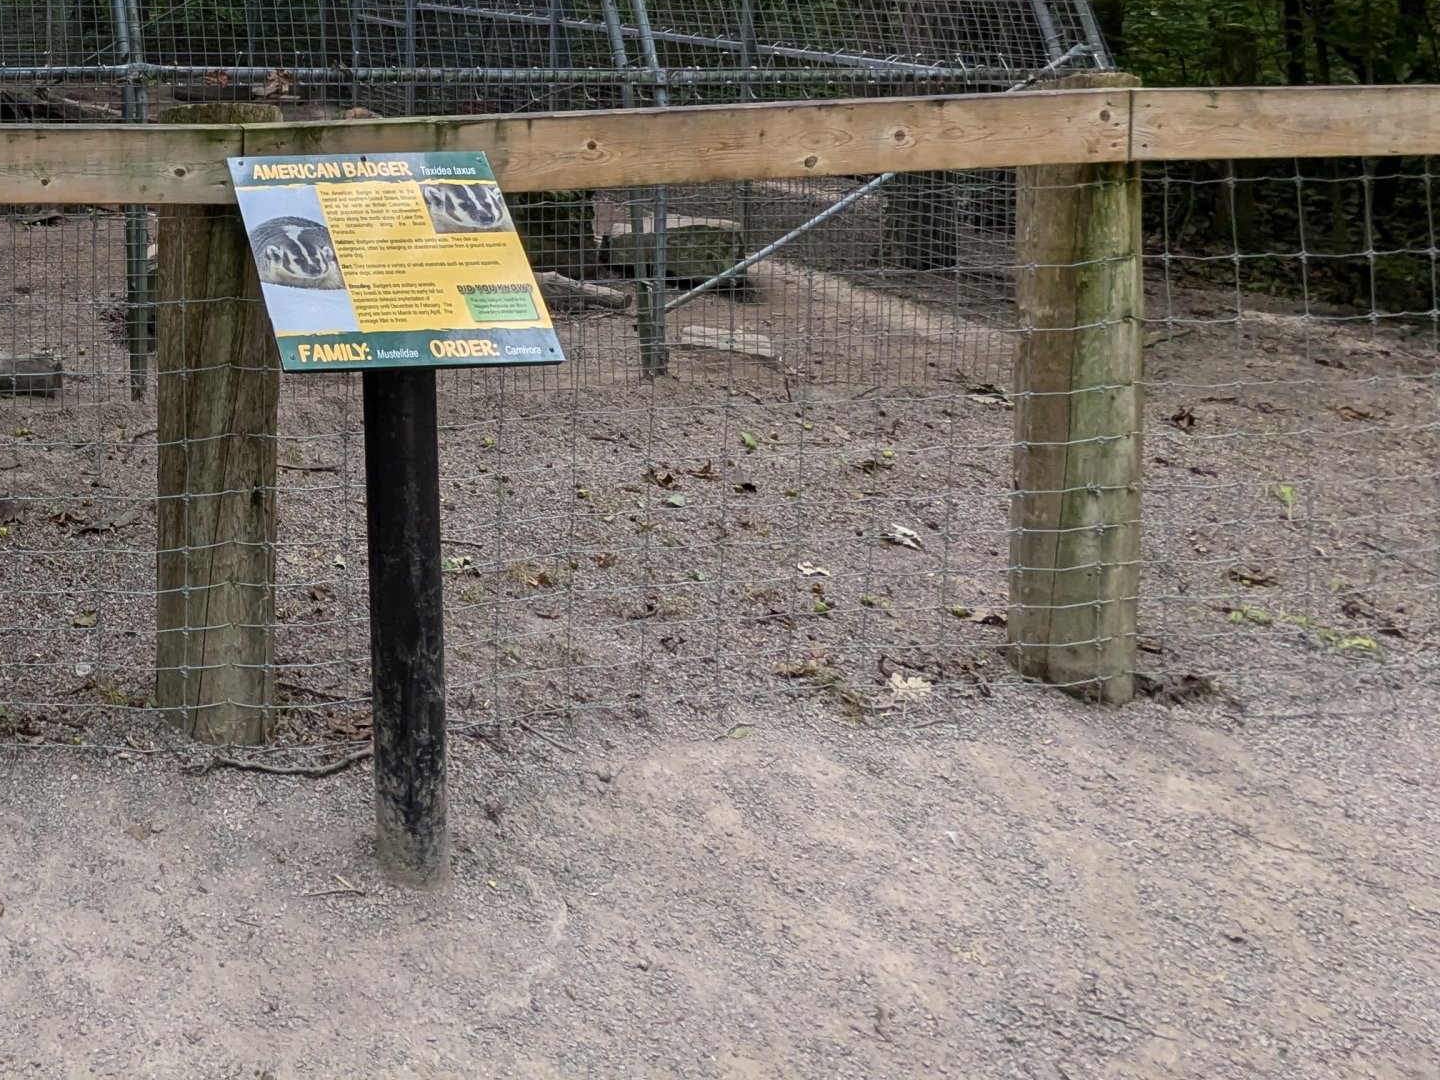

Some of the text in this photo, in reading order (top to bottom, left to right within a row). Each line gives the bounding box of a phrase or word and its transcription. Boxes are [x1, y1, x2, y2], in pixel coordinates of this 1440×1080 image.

[253, 161, 476, 181] AMERICAN BADGER Taxidea taxus
[456, 284, 476, 295] DID
[474, 284, 498, 294] YOU
[298, 339, 542, 363] FAMILY: Mustelidae ORDER: Carnivora
